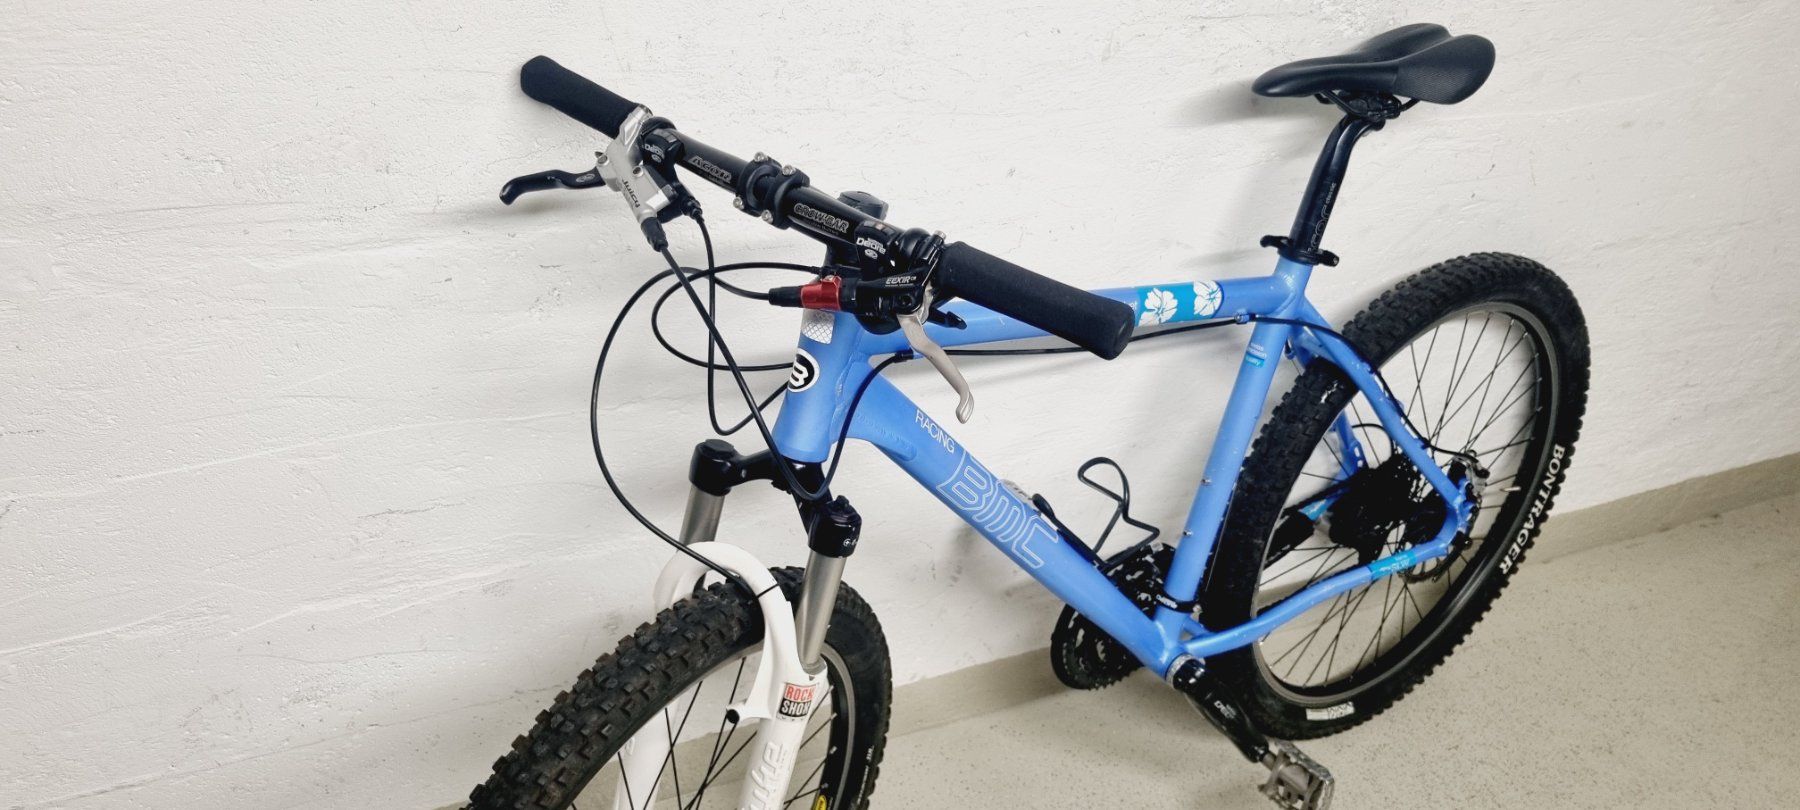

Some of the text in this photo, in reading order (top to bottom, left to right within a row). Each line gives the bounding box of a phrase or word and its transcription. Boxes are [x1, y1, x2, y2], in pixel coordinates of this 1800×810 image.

[856, 237, 886, 254] Deore
[915, 410, 955, 454] RACING
[936, 449, 1059, 569] BMC
[1500, 444, 1565, 574] BONTRAGER
